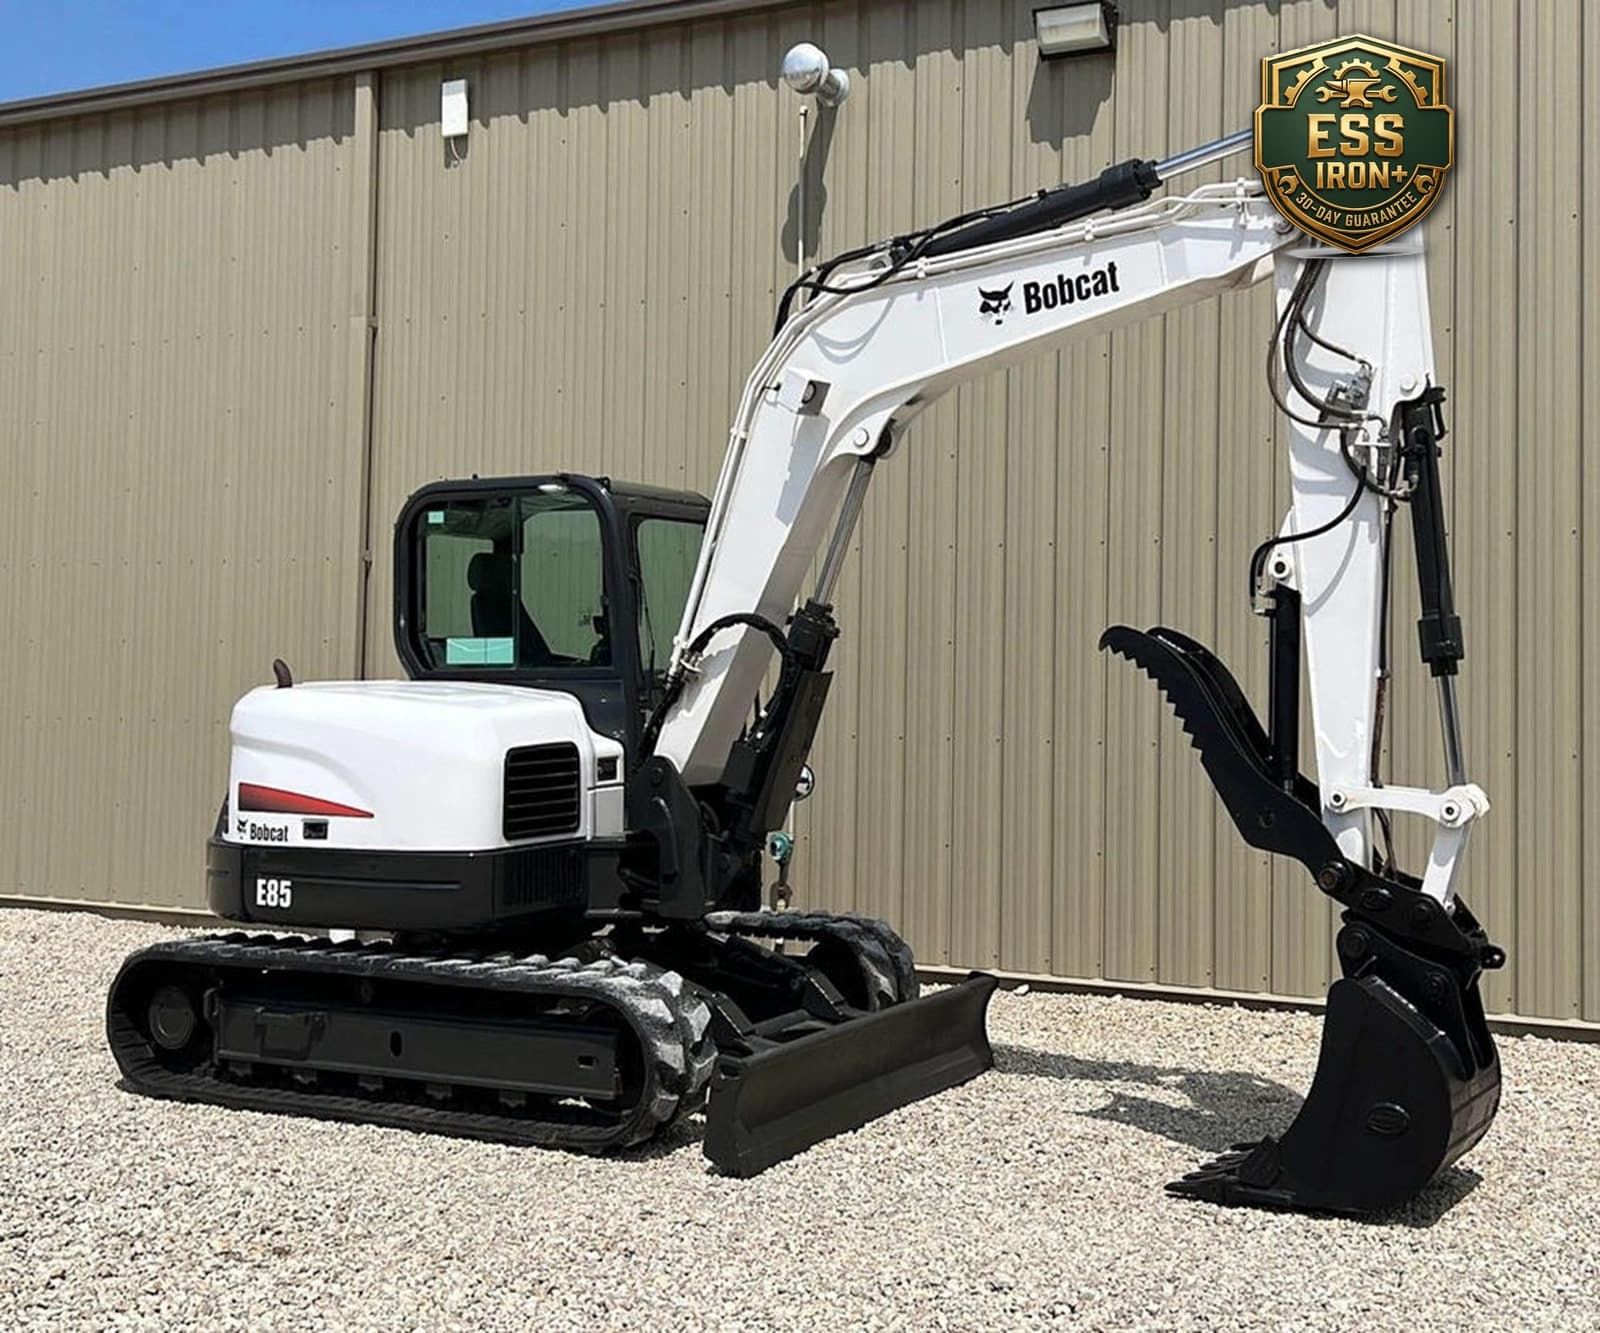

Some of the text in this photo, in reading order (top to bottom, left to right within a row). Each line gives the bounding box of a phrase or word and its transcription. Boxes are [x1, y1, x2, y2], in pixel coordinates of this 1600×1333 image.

[1023, 261, 1120, 315] Bobcat
[250, 823, 289, 842] Bobcat
[256, 878, 292, 908] E85
